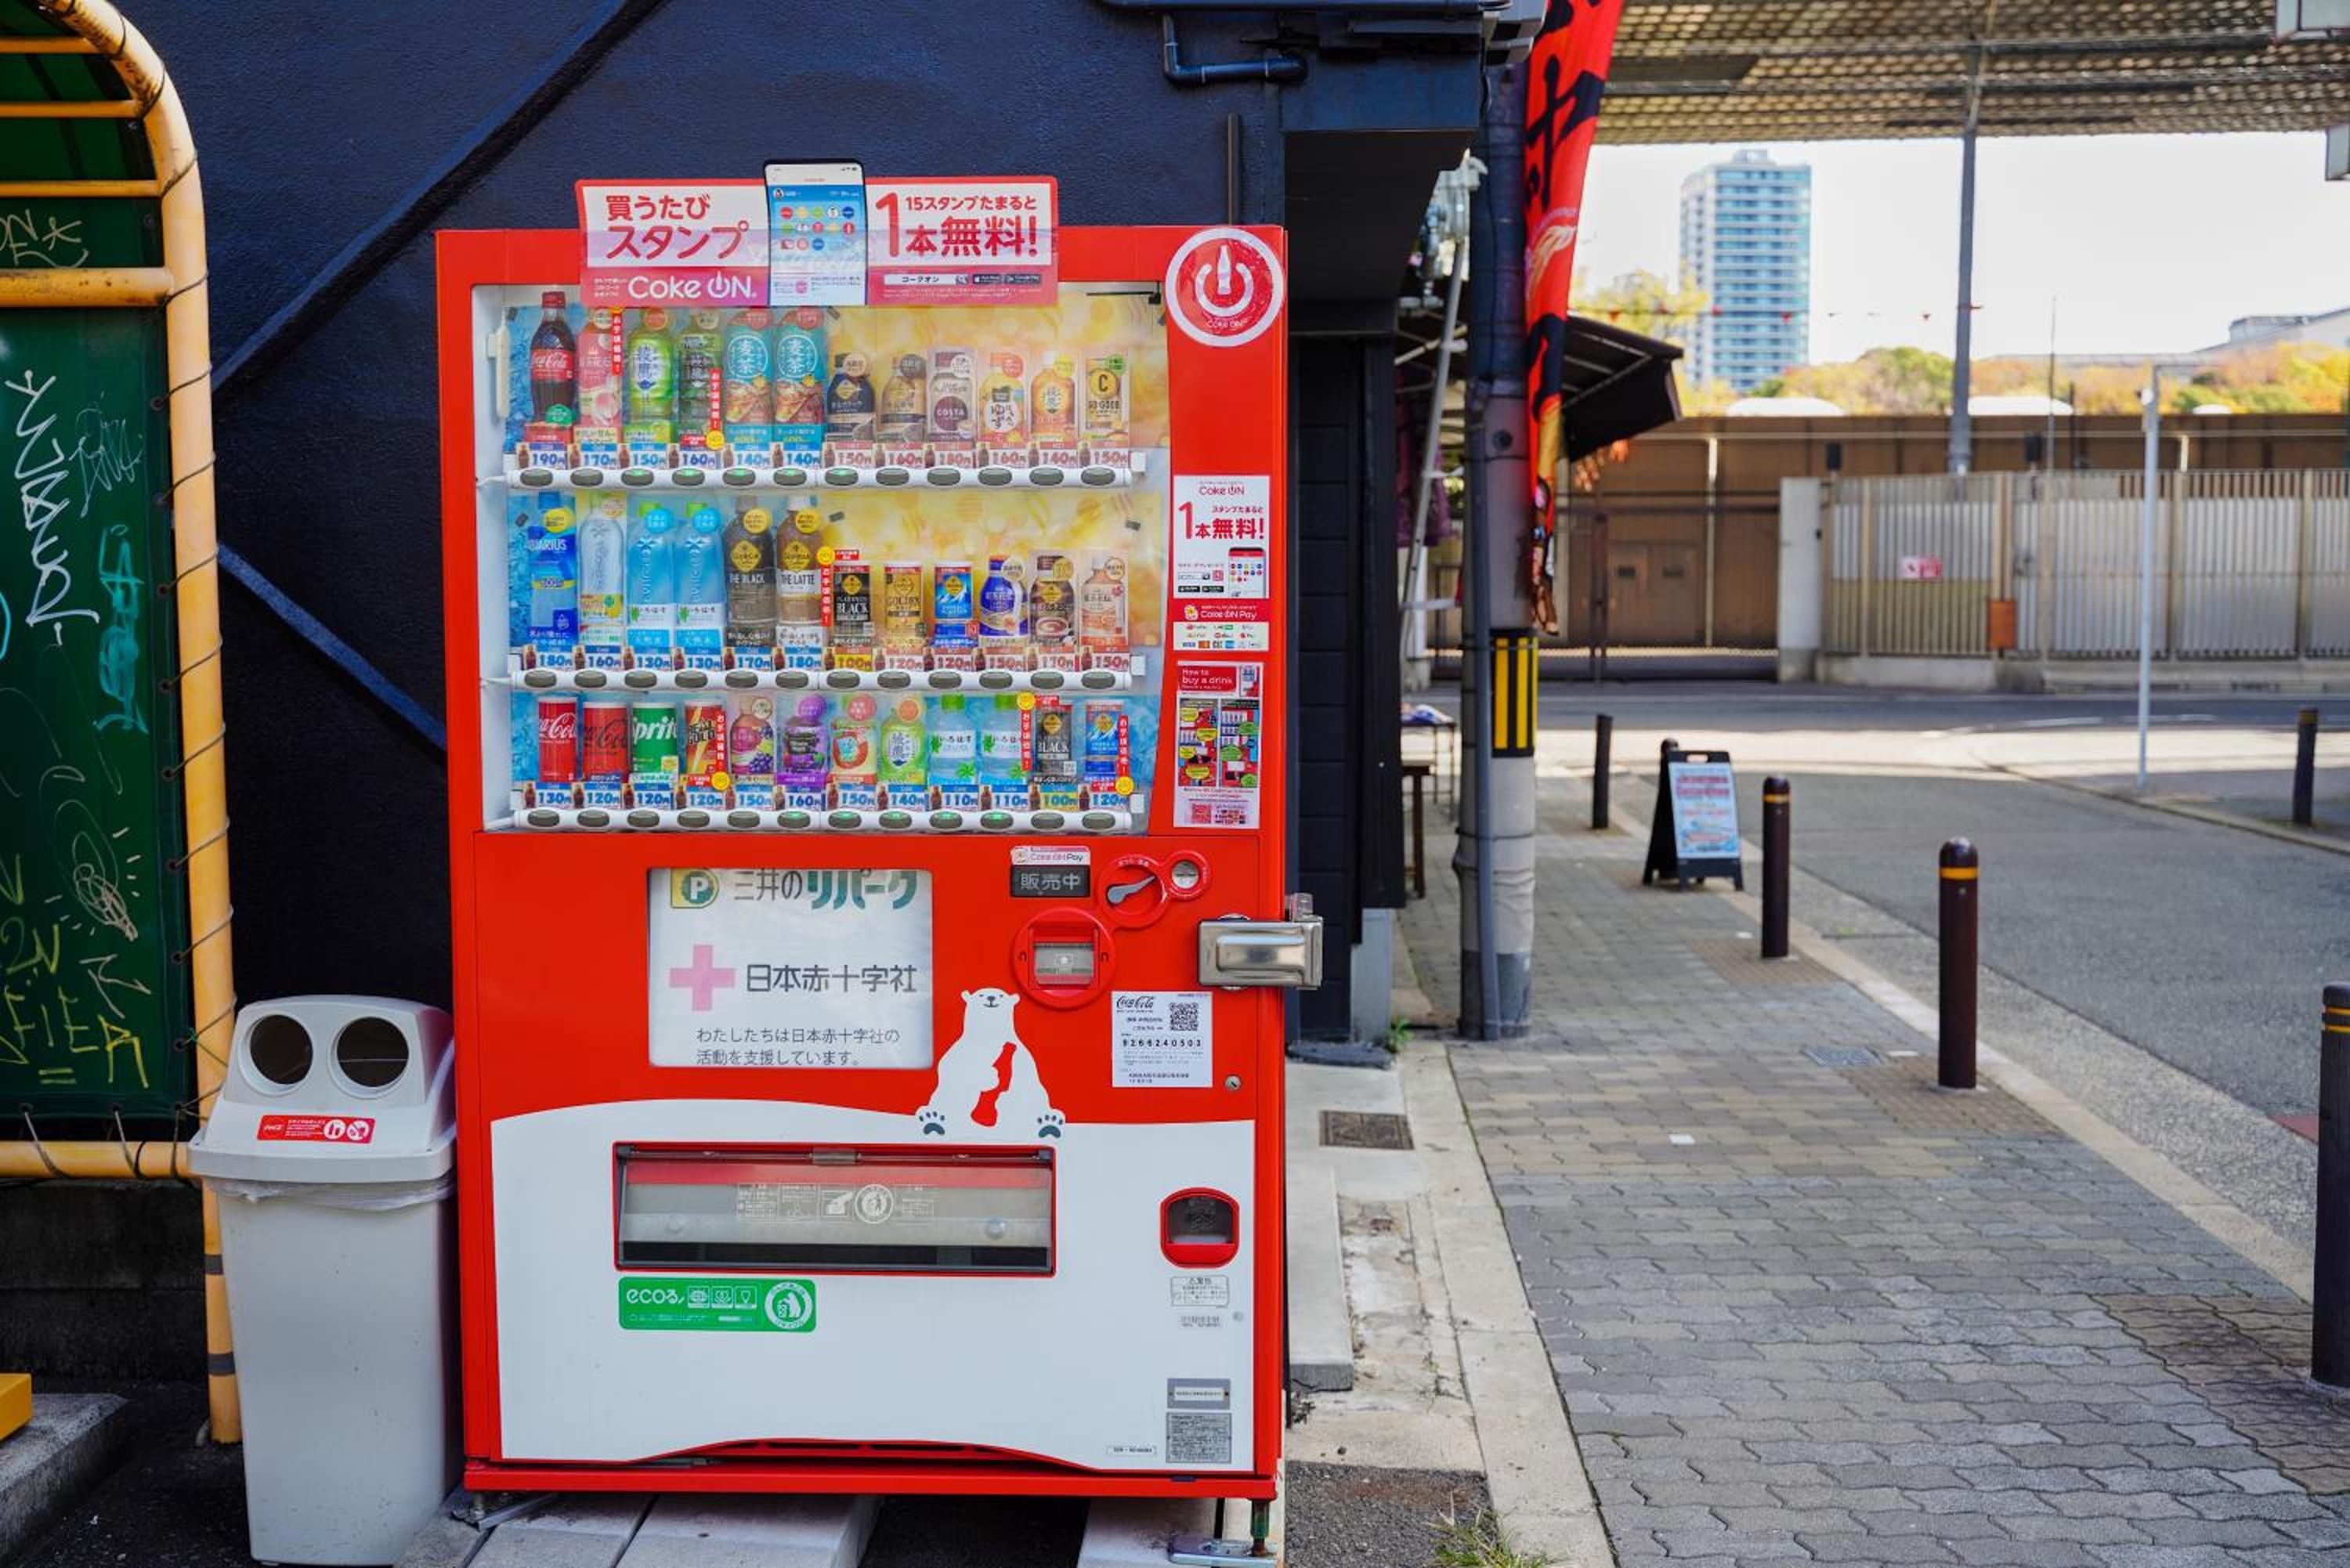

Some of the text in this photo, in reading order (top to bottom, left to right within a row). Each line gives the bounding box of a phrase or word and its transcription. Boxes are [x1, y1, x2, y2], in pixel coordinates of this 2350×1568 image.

[606, 193, 710, 222] 買うたび
[906, 196, 1037, 211] 15スタンプたまると
[606, 220, 750, 259] スタンプ
[628, 275, 702, 299] Coke
[936, 408, 965, 417] COSTA
[532, 453, 565, 465] 190円
[584, 453, 616, 465] 170円
[633, 453, 665, 465] 150円
[682, 453, 715, 465] 160円
[737, 453, 770, 465] 140円
[786, 453, 819, 465] 140円
[838, 453, 872, 464] 150円
[888, 453, 922, 464] 160円
[1199, 486, 1227, 496] Coke
[793, 574, 815, 584] LATTE
[837, 602, 869, 614] BLACK
[1239, 611, 1257, 620] Pay
[540, 655, 572, 667] 180円
[588, 655, 621, 667] 160円
[687, 656, 720, 667] 130円
[738, 656, 770, 667] 170円
[788, 656, 822, 667] 180円
[838, 658, 871, 669] 100円
[938, 658, 973, 669] 120円
[989, 657, 1022, 669] 150円
[1097, 656, 1129, 668] 150円
[1182, 677, 1199, 685] buy
[539, 793, 571, 804] 130円
[588, 793, 620, 804] 120円
[636, 793, 671, 804] 120円
[689, 794, 723, 805] 120円
[739, 794, 772, 805] 150円
[789, 794, 822, 806] 160円
[842, 793, 875, 805] 150円
[891, 793, 924, 805] 140円
[945, 794, 978, 805] 110円
[995, 794, 1028, 806] 110円
[1044, 794, 1077, 805] 100円
[1021, 873, 1081, 891] 販売中
[747, 964, 917, 993] 日本赤十字社
[696, 1028, 901, 1043] わたしたちは日本赤十字社の
[696, 1050, 859, 1066] 活動を支援しています。
